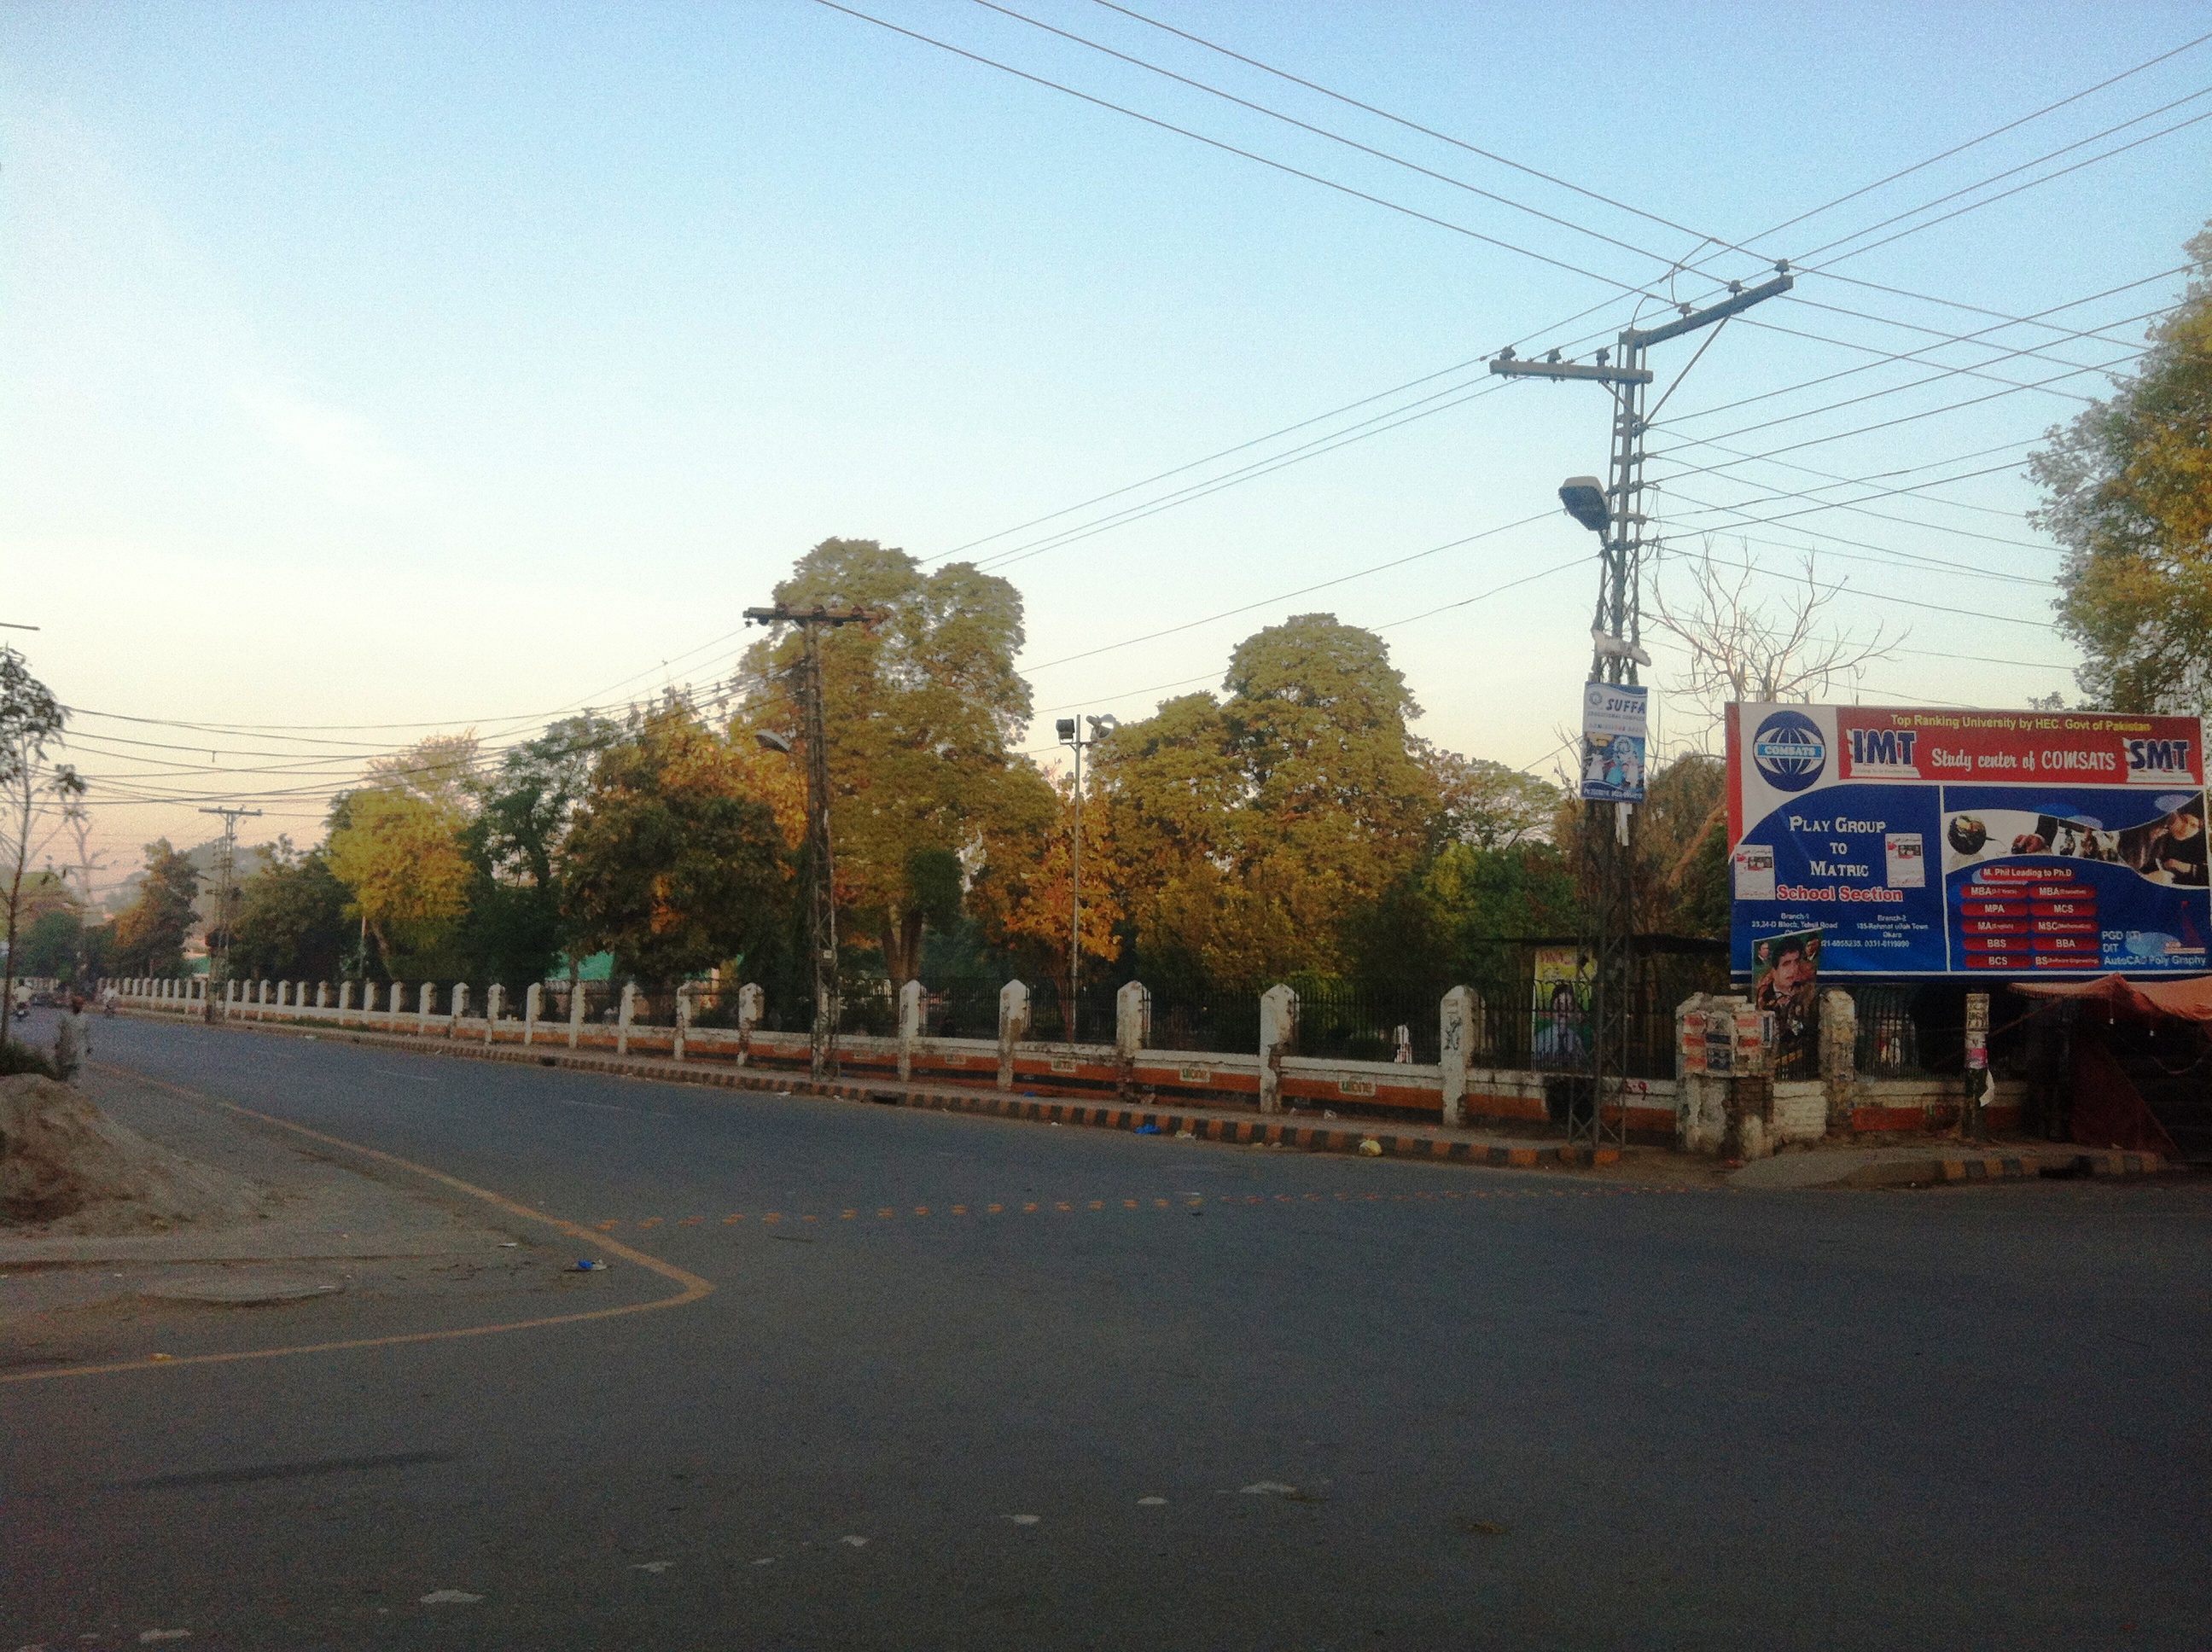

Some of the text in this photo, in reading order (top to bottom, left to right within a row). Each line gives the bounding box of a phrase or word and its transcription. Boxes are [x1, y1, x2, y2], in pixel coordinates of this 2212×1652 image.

[1606, 698, 1645, 714] SUFFA
[1891, 714, 1911, 727] Top
[1913, 714, 1960, 729] Ranking
[1962, 717, 2017, 730] University
[2019, 718, 2033, 732] by
[2065, 720, 2090, 730] Govt
[2093, 720, 2103, 731] of
[2106, 721, 2152, 732] Pakistan
[1764, 745, 1816, 757] COMSATS
[1852, 729, 1918, 765] IMT
[2129, 738, 2190, 771] SMT
[1931, 748, 2116, 771] Study center of COMSATS
[2011, 869, 2042, 878] Leading
[1776, 884, 1904, 903] School Section
[1970, 887, 1992, 896] MBA
[2039, 887, 2060, 896] MBA
[1984, 904, 2005, 913] MPA
[2053, 905, 2074, 913] MCS
[1977, 922, 1992, 930] MA
[2101, 930, 2123, 940] PGD
[2056, 939, 2075, 947] BBA
[2103, 943, 2119, 952] DIT
[1988, 957, 2008, 965] BCS
